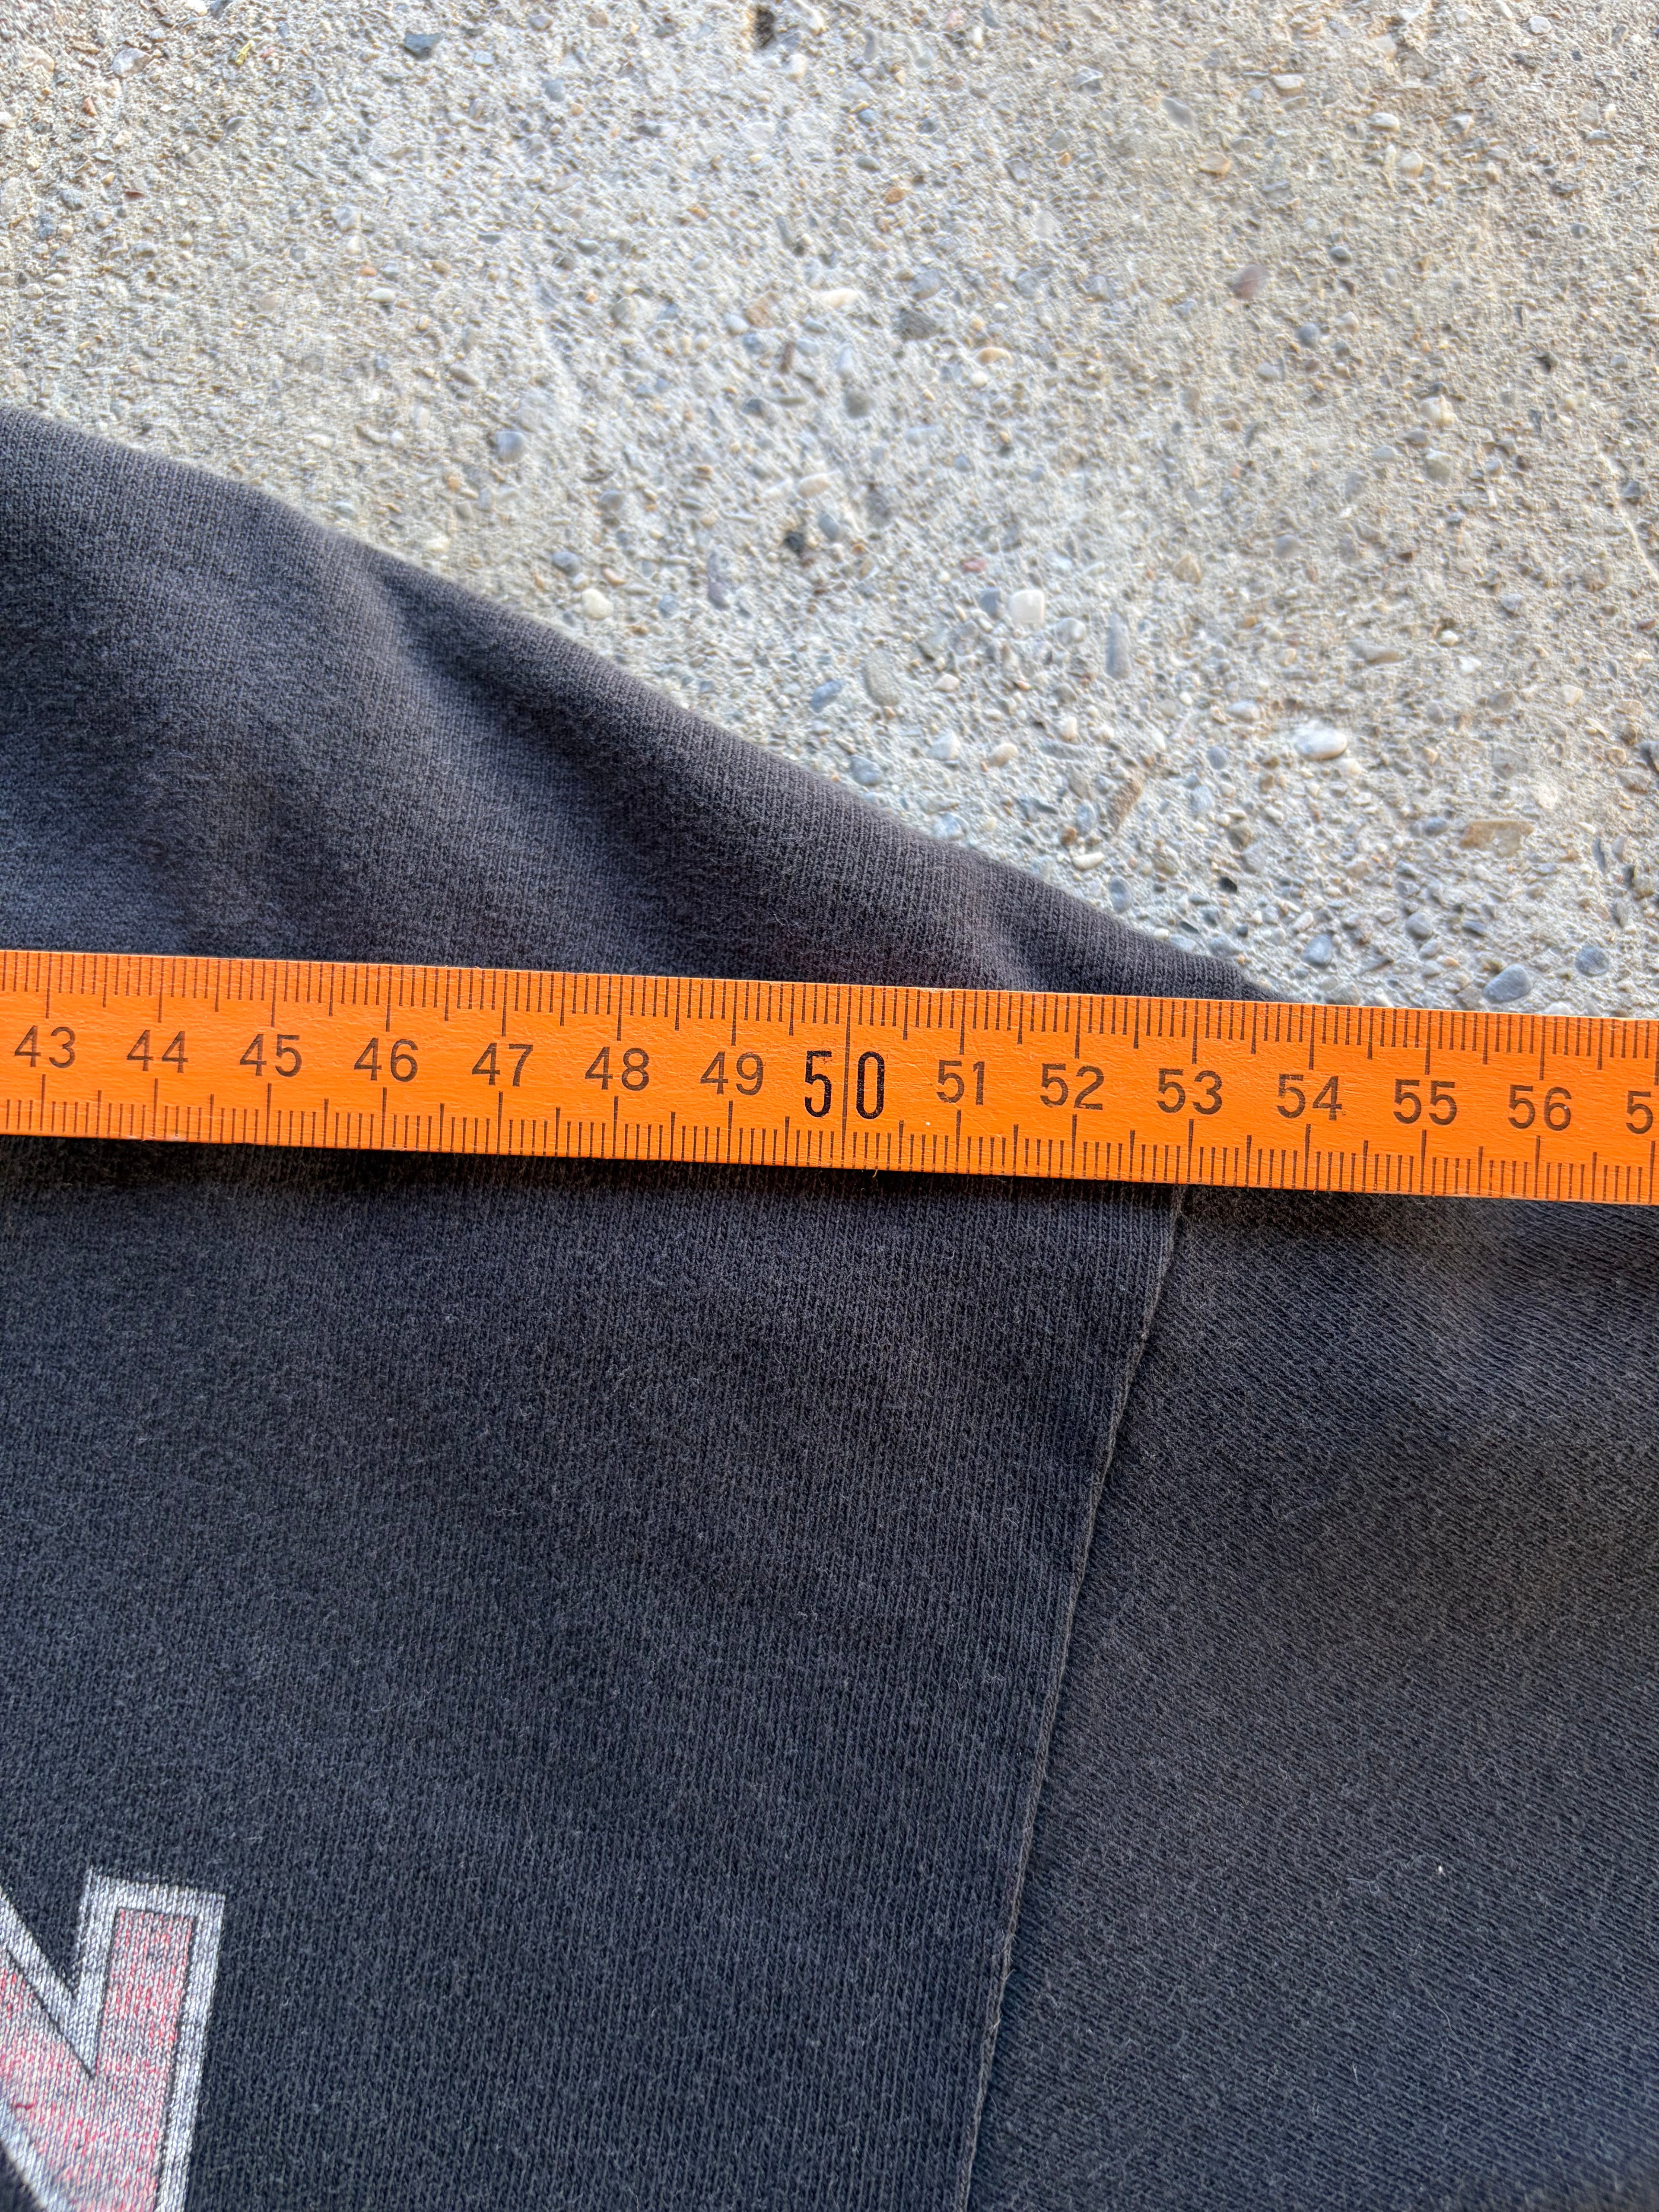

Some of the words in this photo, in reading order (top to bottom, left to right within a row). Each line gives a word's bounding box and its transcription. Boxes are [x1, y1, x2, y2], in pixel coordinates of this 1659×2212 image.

[14, 1025, 76, 1069] 43
[127, 1029, 188, 1074] 44
[239, 1033, 302, 1077] 45
[353, 1038, 418, 1083] 46
[471, 1042, 534, 1087] 47
[584, 1047, 650, 1091] 48
[700, 1052, 764, 1096] 49
[804, 1050, 886, 1120] 50
[937, 1060, 985, 1106] 51
[1040, 1063, 1104, 1110] 52
[1157, 1068, 1223, 1115] 53
[1277, 1074, 1342, 1120] 54
[1394, 1079, 1458, 1125] 55
[1508, 1084, 1573, 1131] 56
